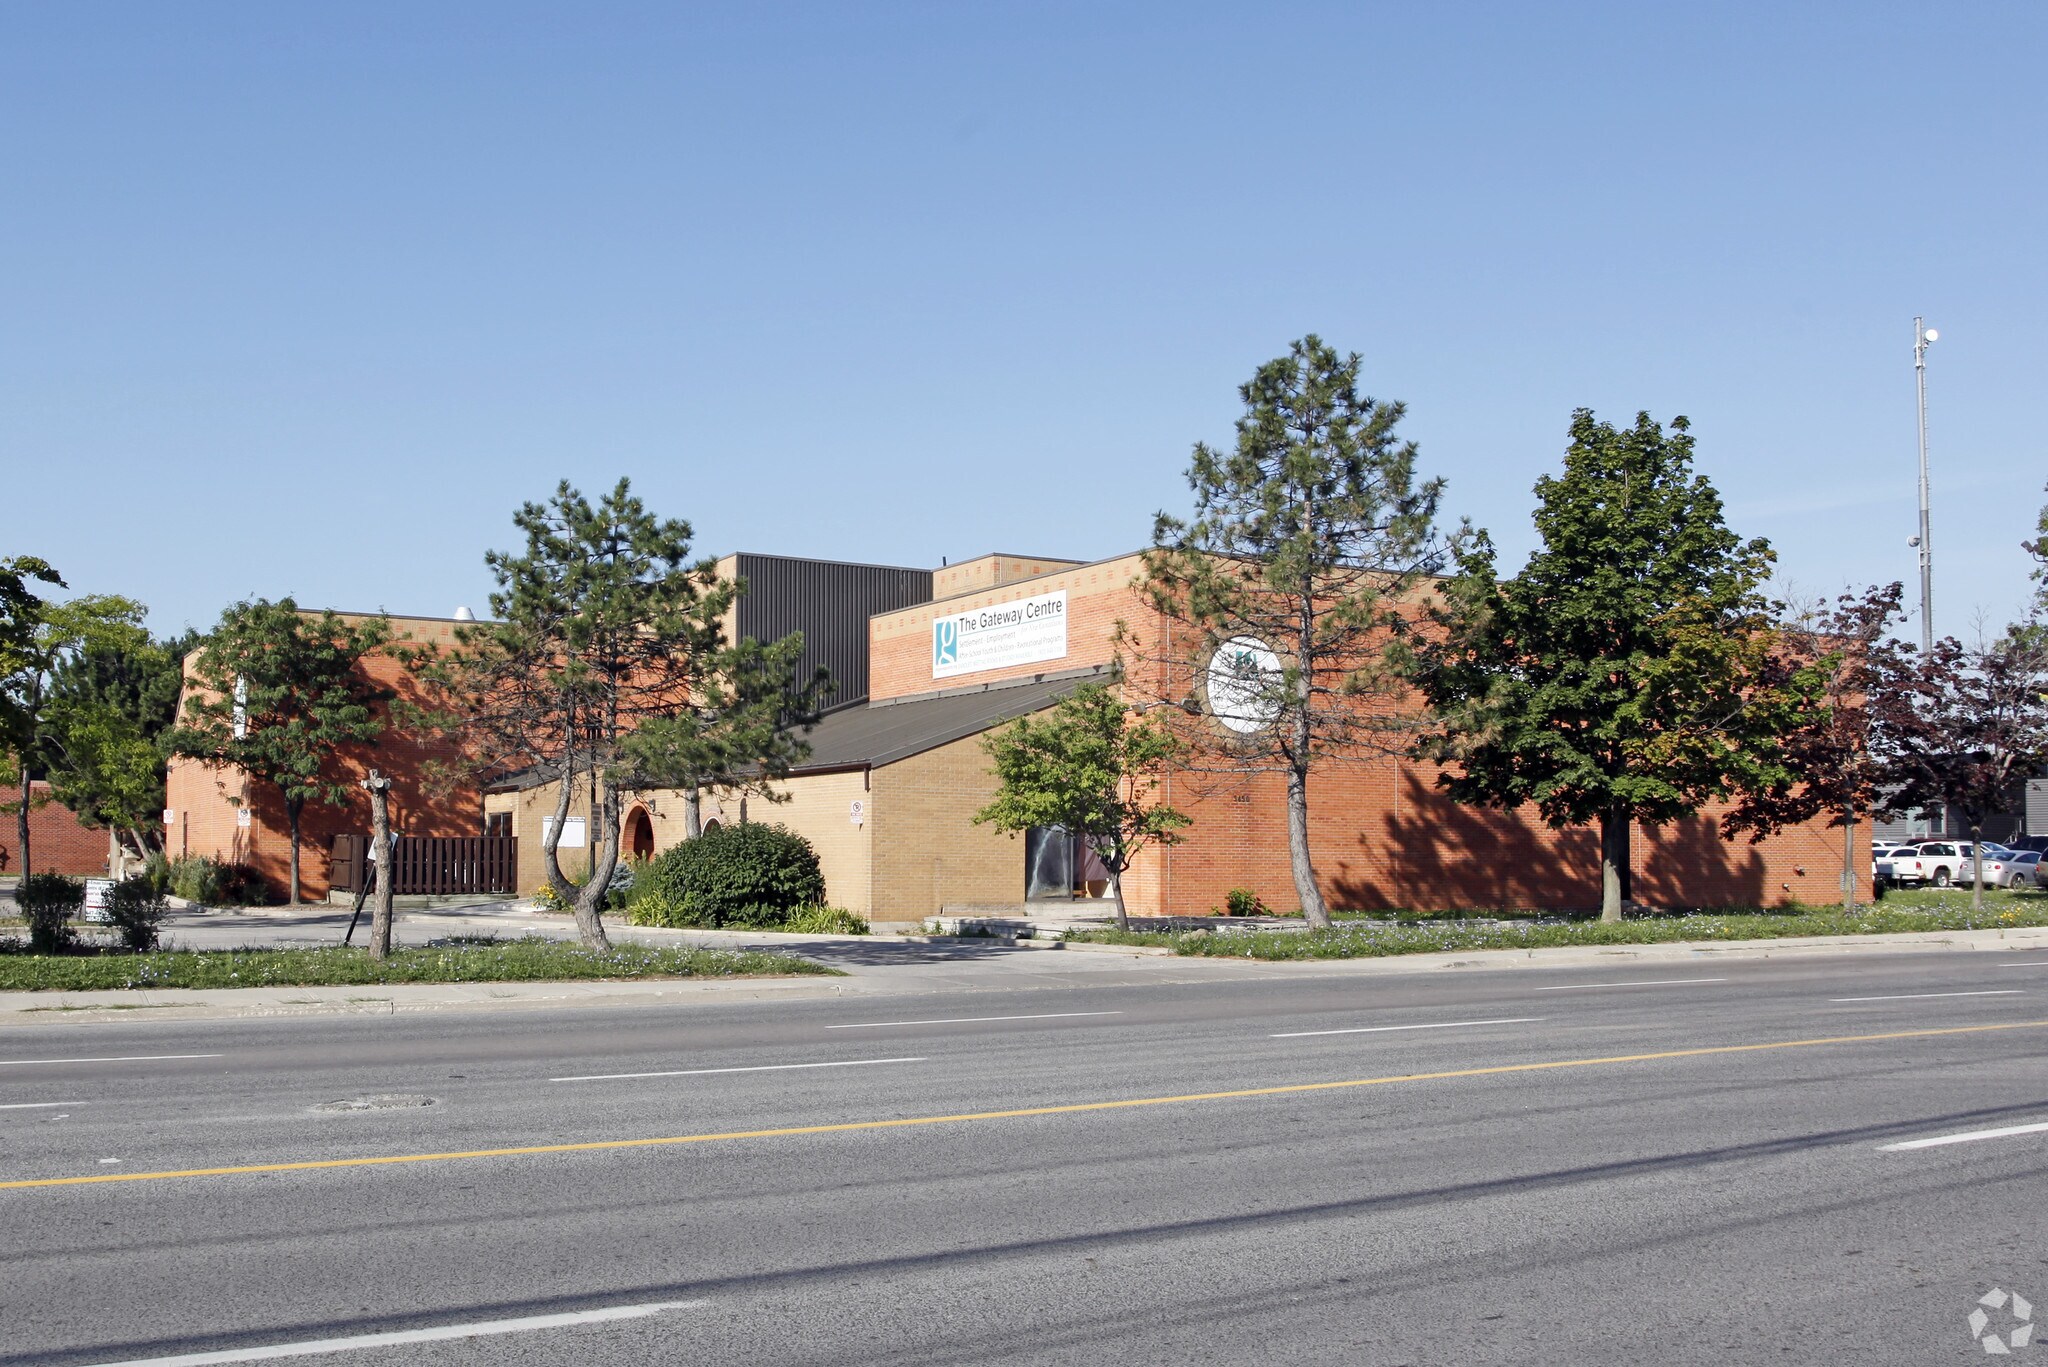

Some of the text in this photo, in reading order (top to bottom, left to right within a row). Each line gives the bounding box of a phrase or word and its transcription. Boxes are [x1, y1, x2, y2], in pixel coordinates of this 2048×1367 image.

[959, 600, 1062, 632] The Gateway Centre
